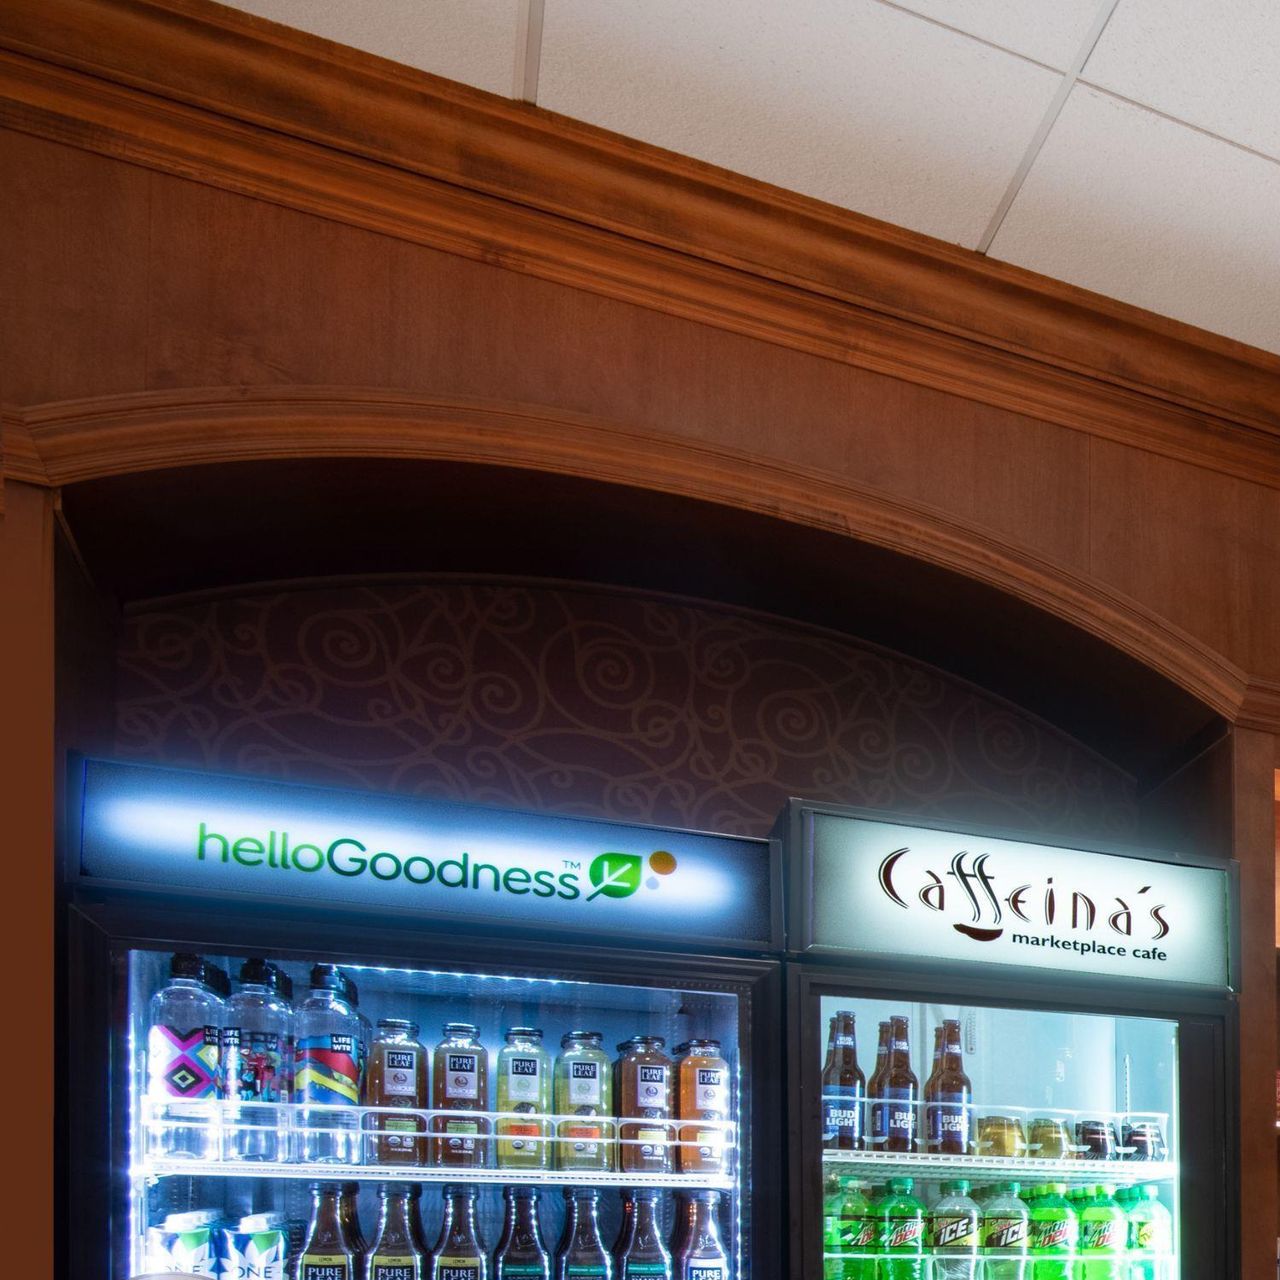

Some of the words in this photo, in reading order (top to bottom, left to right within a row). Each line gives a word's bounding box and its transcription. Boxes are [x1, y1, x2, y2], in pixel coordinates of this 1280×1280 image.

[878, 847, 1170, 940] Caffeina's
[1012, 932, 1126, 957] marketplace
[1132, 947, 1167, 961] cafe
[451, 1056, 474, 1064] PURE
[513, 1060, 536, 1068] PURE
[451, 1063, 474, 1071] LEAF
[513, 1067, 536, 1075] LEAF
[573, 1063, 596, 1071] PURE
[642, 1067, 663, 1075] PURE
[574, 1070, 596, 1078] LEAF
[642, 1074, 663, 1082] LEAF
[700, 1070, 720, 1078] PURE
[830, 1109, 855, 1118] BUD
[895, 1112, 915, 1120] BUD
[827, 1118, 857, 1126] LIGHT
[939, 1219, 968, 1244] ICE
[308, 1267, 342, 1277] PURE
[378, 1268, 411, 1278] PURE
[443, 1269, 475, 1278] PURE
